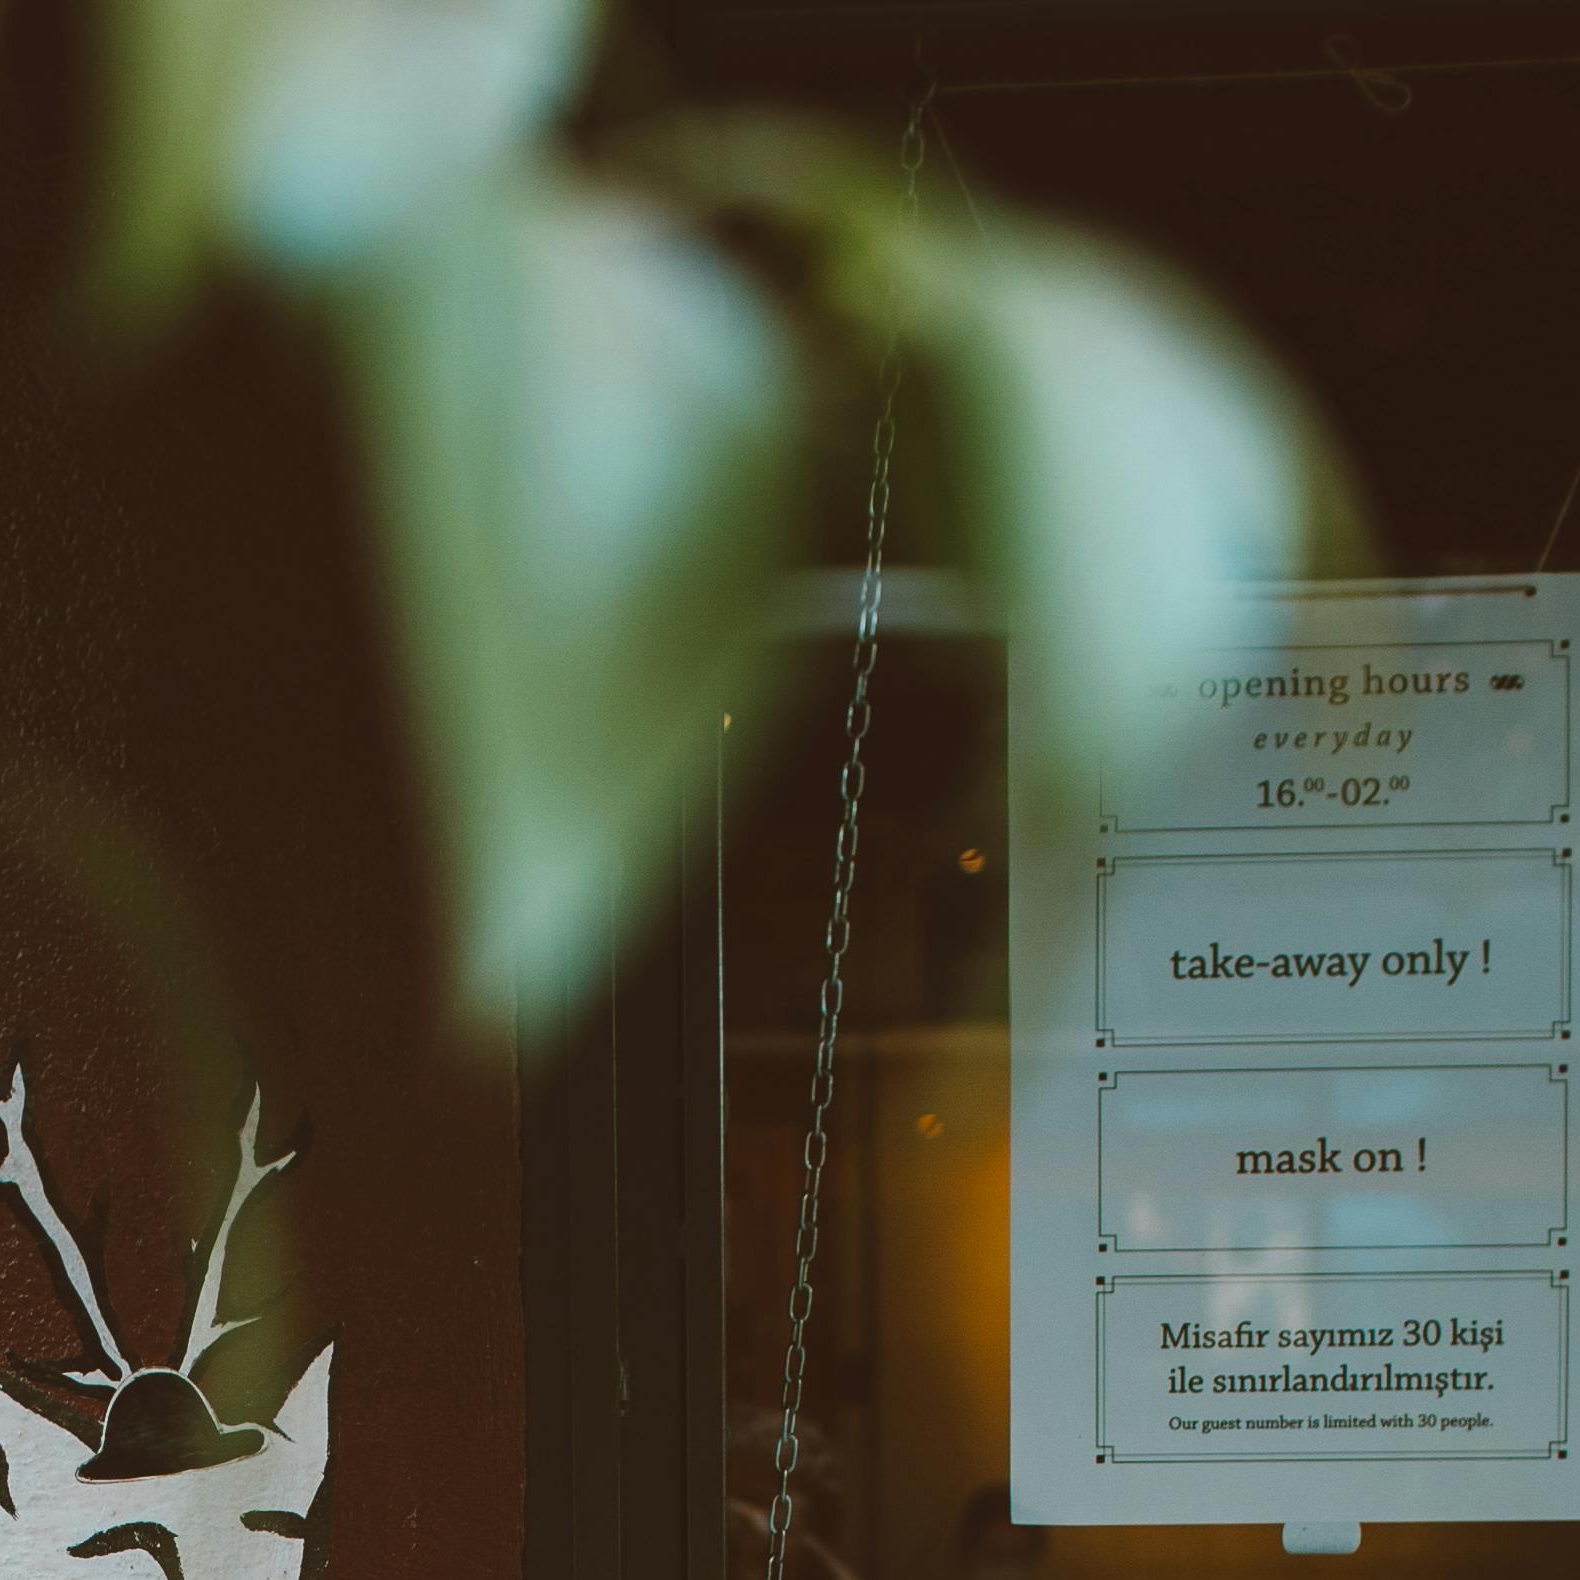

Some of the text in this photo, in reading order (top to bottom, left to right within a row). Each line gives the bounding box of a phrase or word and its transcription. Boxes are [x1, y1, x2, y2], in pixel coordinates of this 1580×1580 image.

[1198, 664, 1471, 708] opening hours
[1252, 722, 1413, 755] everyday
[1170, 942, 1371, 988] take-away
[1381, 939, 1470, 986] only
[1235, 1138, 1343, 1175] mask
[1353, 1146, 1405, 1173] on
[1160, 1318, 1505, 1356] Misafir sayımız 30 kişi
[1168, 1365, 1204, 1394] ile
[1169, 1413, 1494, 1434] Our guest number is limited with 30 people.
